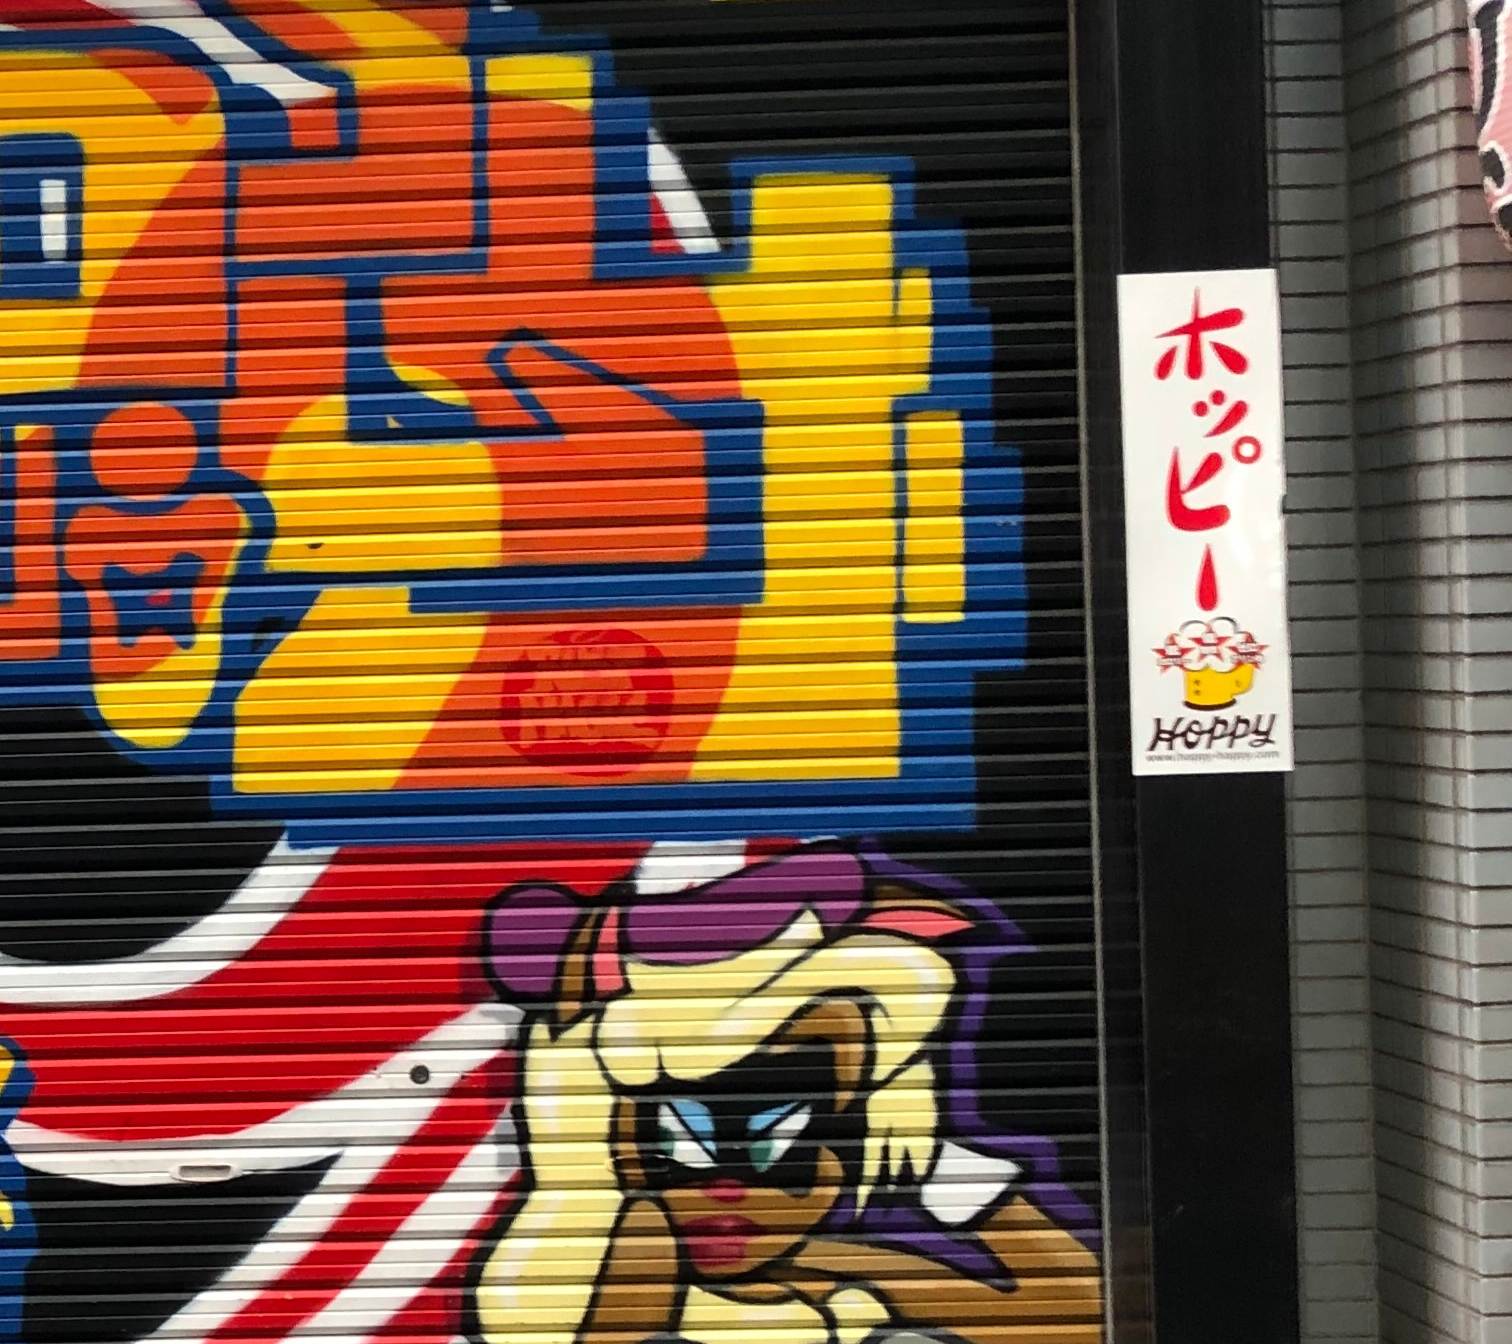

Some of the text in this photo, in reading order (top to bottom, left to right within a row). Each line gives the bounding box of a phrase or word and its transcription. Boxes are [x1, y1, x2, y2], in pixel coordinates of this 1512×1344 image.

[1154, 286, 1263, 612] ホッピー
[1147, 713, 1277, 752] Hoppy
